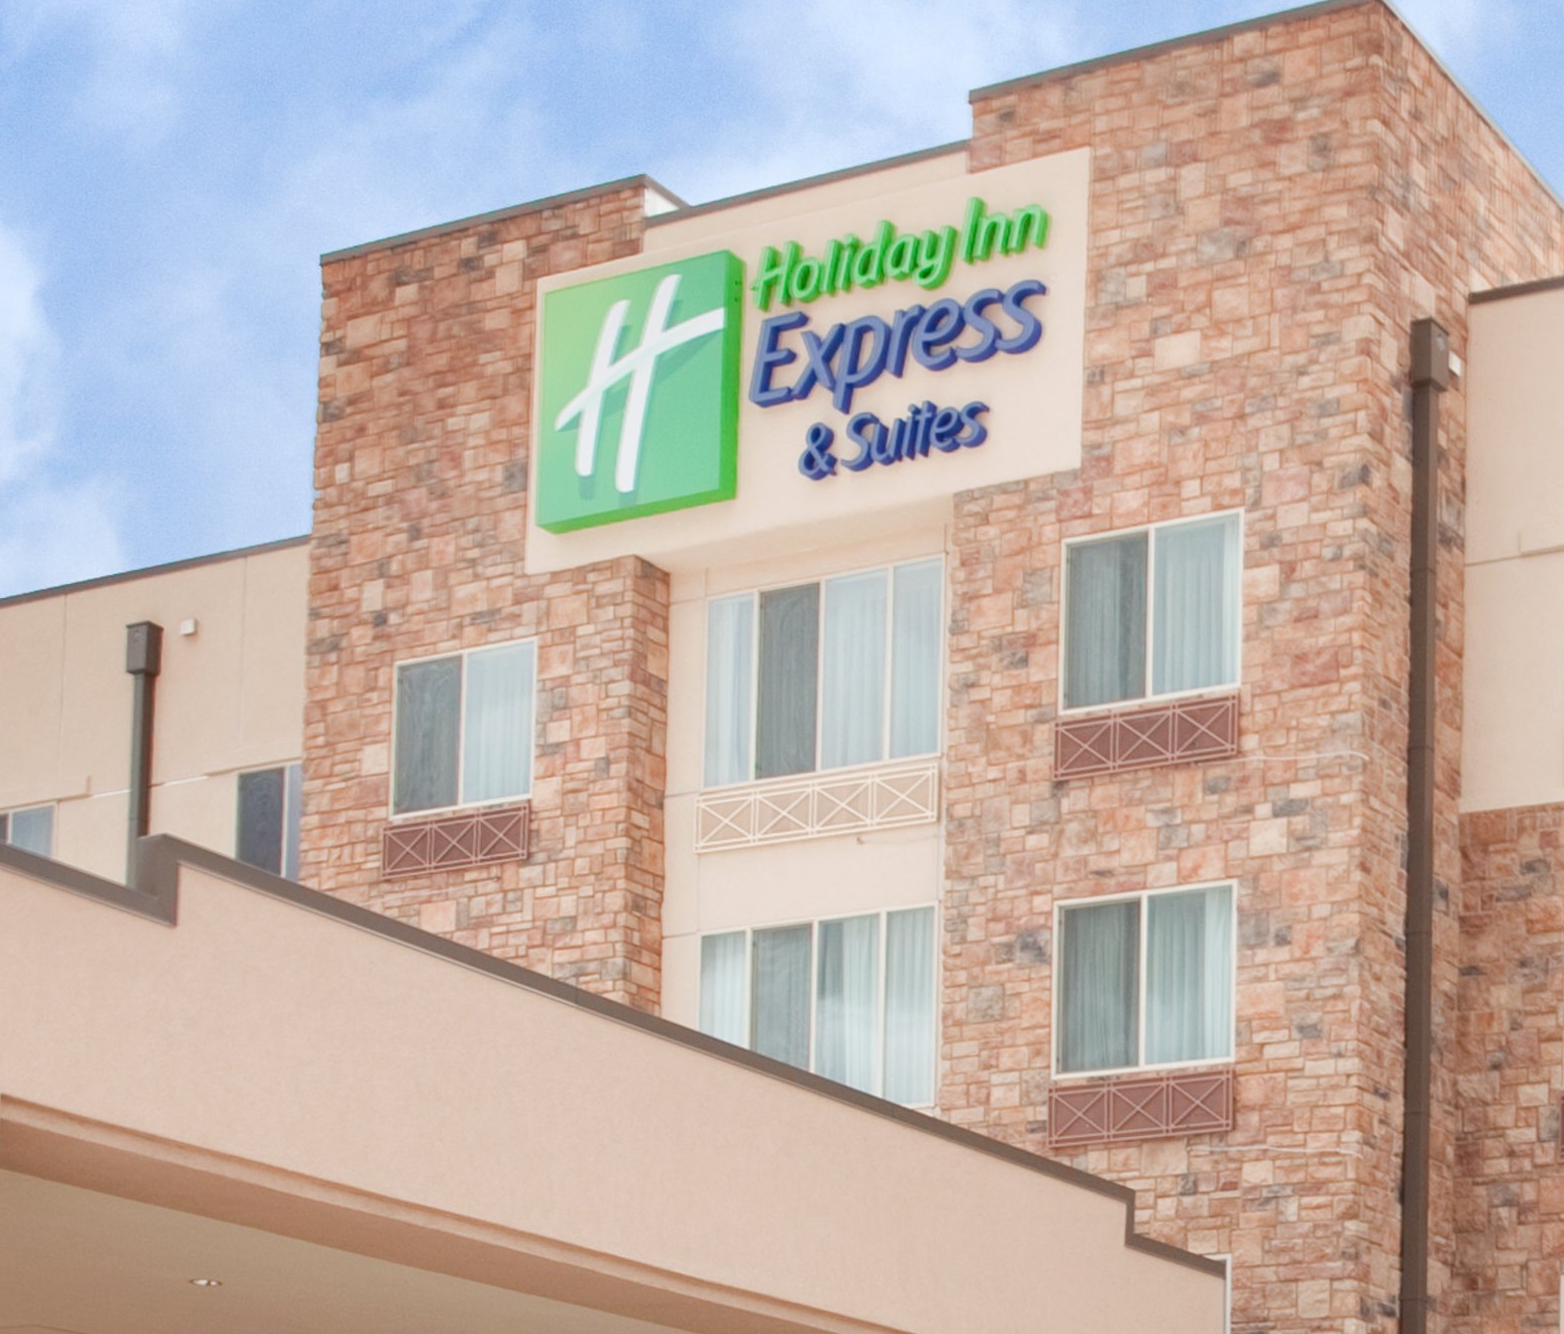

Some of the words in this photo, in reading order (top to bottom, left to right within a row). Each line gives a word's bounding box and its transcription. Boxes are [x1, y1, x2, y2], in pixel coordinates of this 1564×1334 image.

[751, 219, 958, 312] Holiday
[960, 197, 1051, 265] Inn
[554, 273, 725, 493] H
[748, 279, 1047, 414] Express
[797, 422, 837, 480] &
[841, 400, 991, 473] Suites
